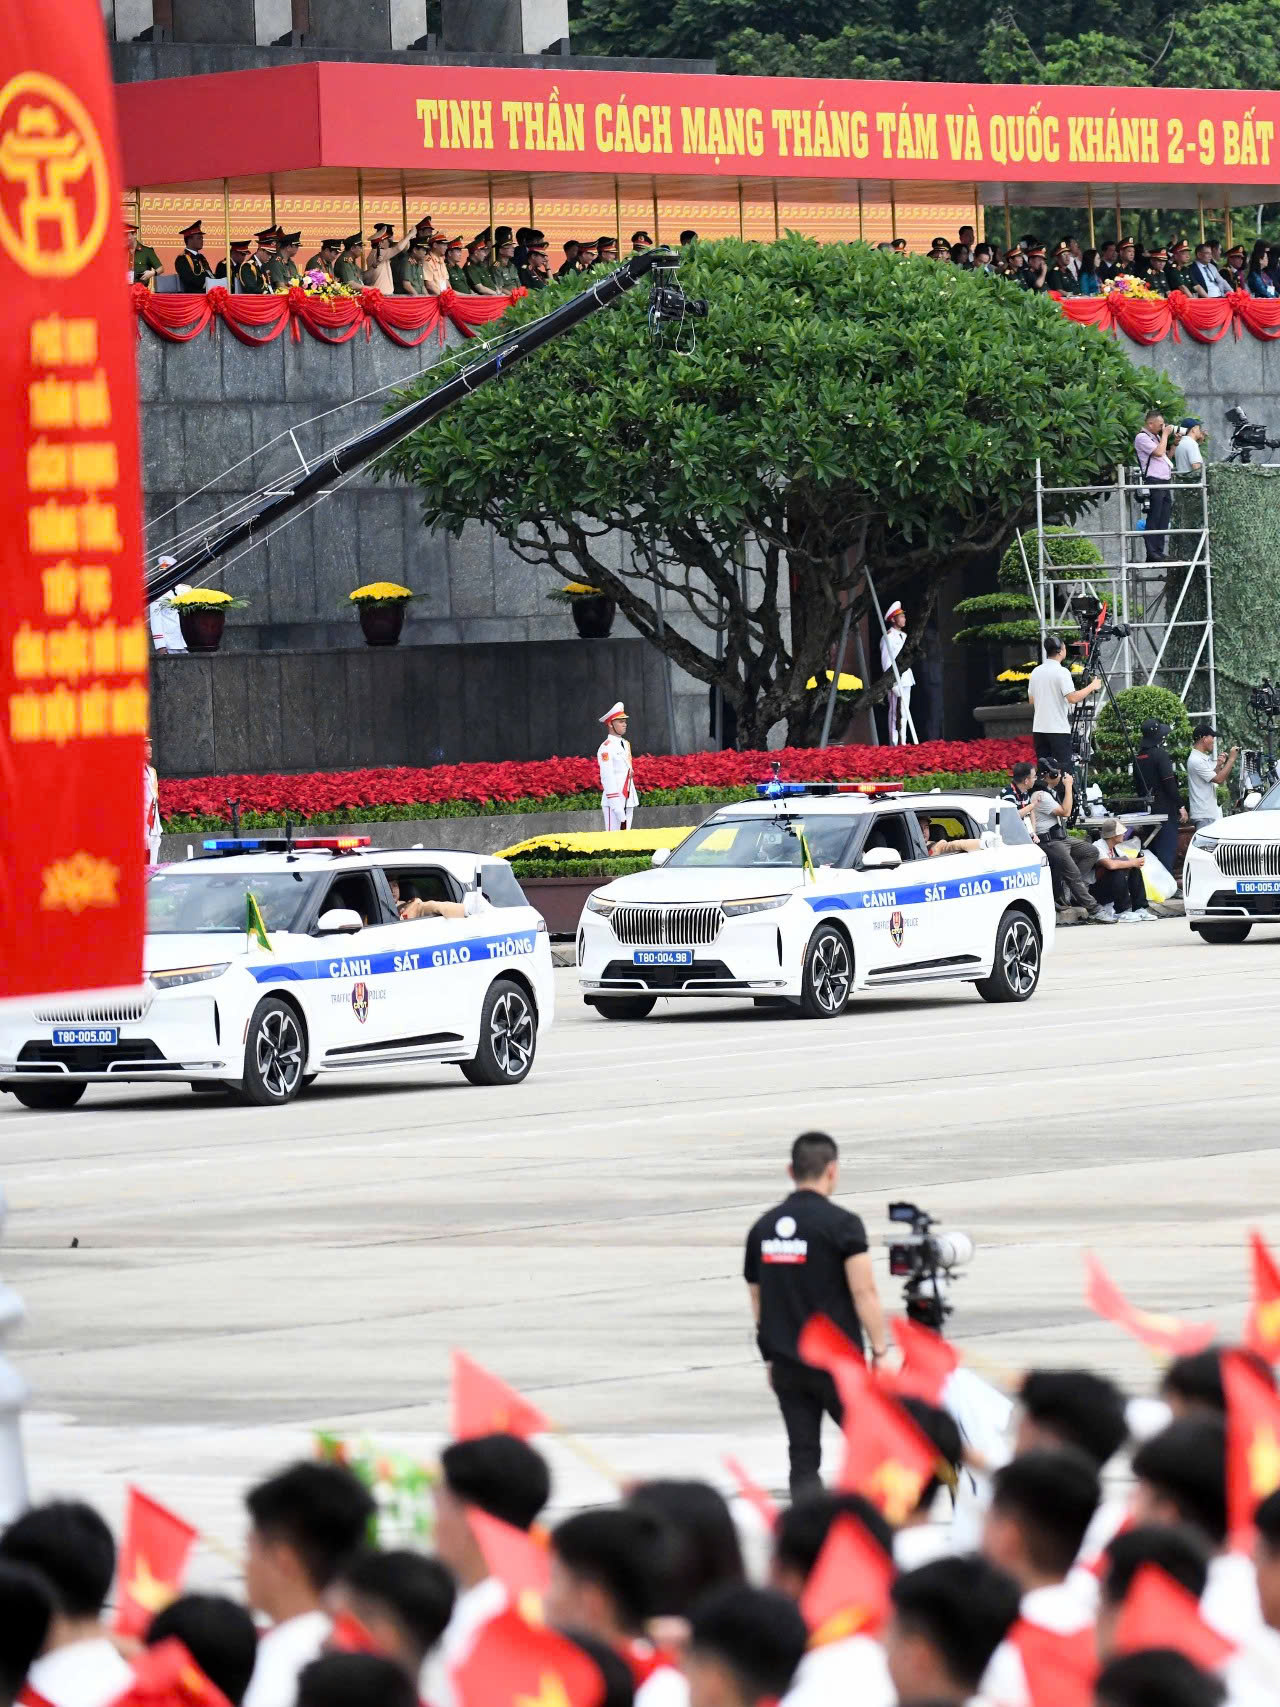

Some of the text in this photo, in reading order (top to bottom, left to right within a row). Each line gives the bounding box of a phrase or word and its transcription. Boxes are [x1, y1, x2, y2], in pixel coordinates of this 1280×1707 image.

[417, 99, 493, 149] TINH
[502, 85, 585, 151] THẦN
[595, 93, 673, 154] CÁCH
[680, 106, 764, 165] MẠNG
[772, 100, 869, 159] THÁNG
[877, 102, 938, 160] TÁM
[946, 103, 983, 161] VÀ
[990, 101, 1060, 166] QUỐC
[1068, 107, 1160, 164] KHÁNH
[1167, 119, 1216, 165] 2-9
[1223, 106, 1274, 166] BẤT
[862, 871, 1039, 908] CẢNH SÁT GIAO THÔNG
[329, 937, 533, 978] CẢNH SÁT GIAO THÔNG
[637, 951, 687, 963] T80-004.98
[57, 1030, 112, 1043] T80-005.00
